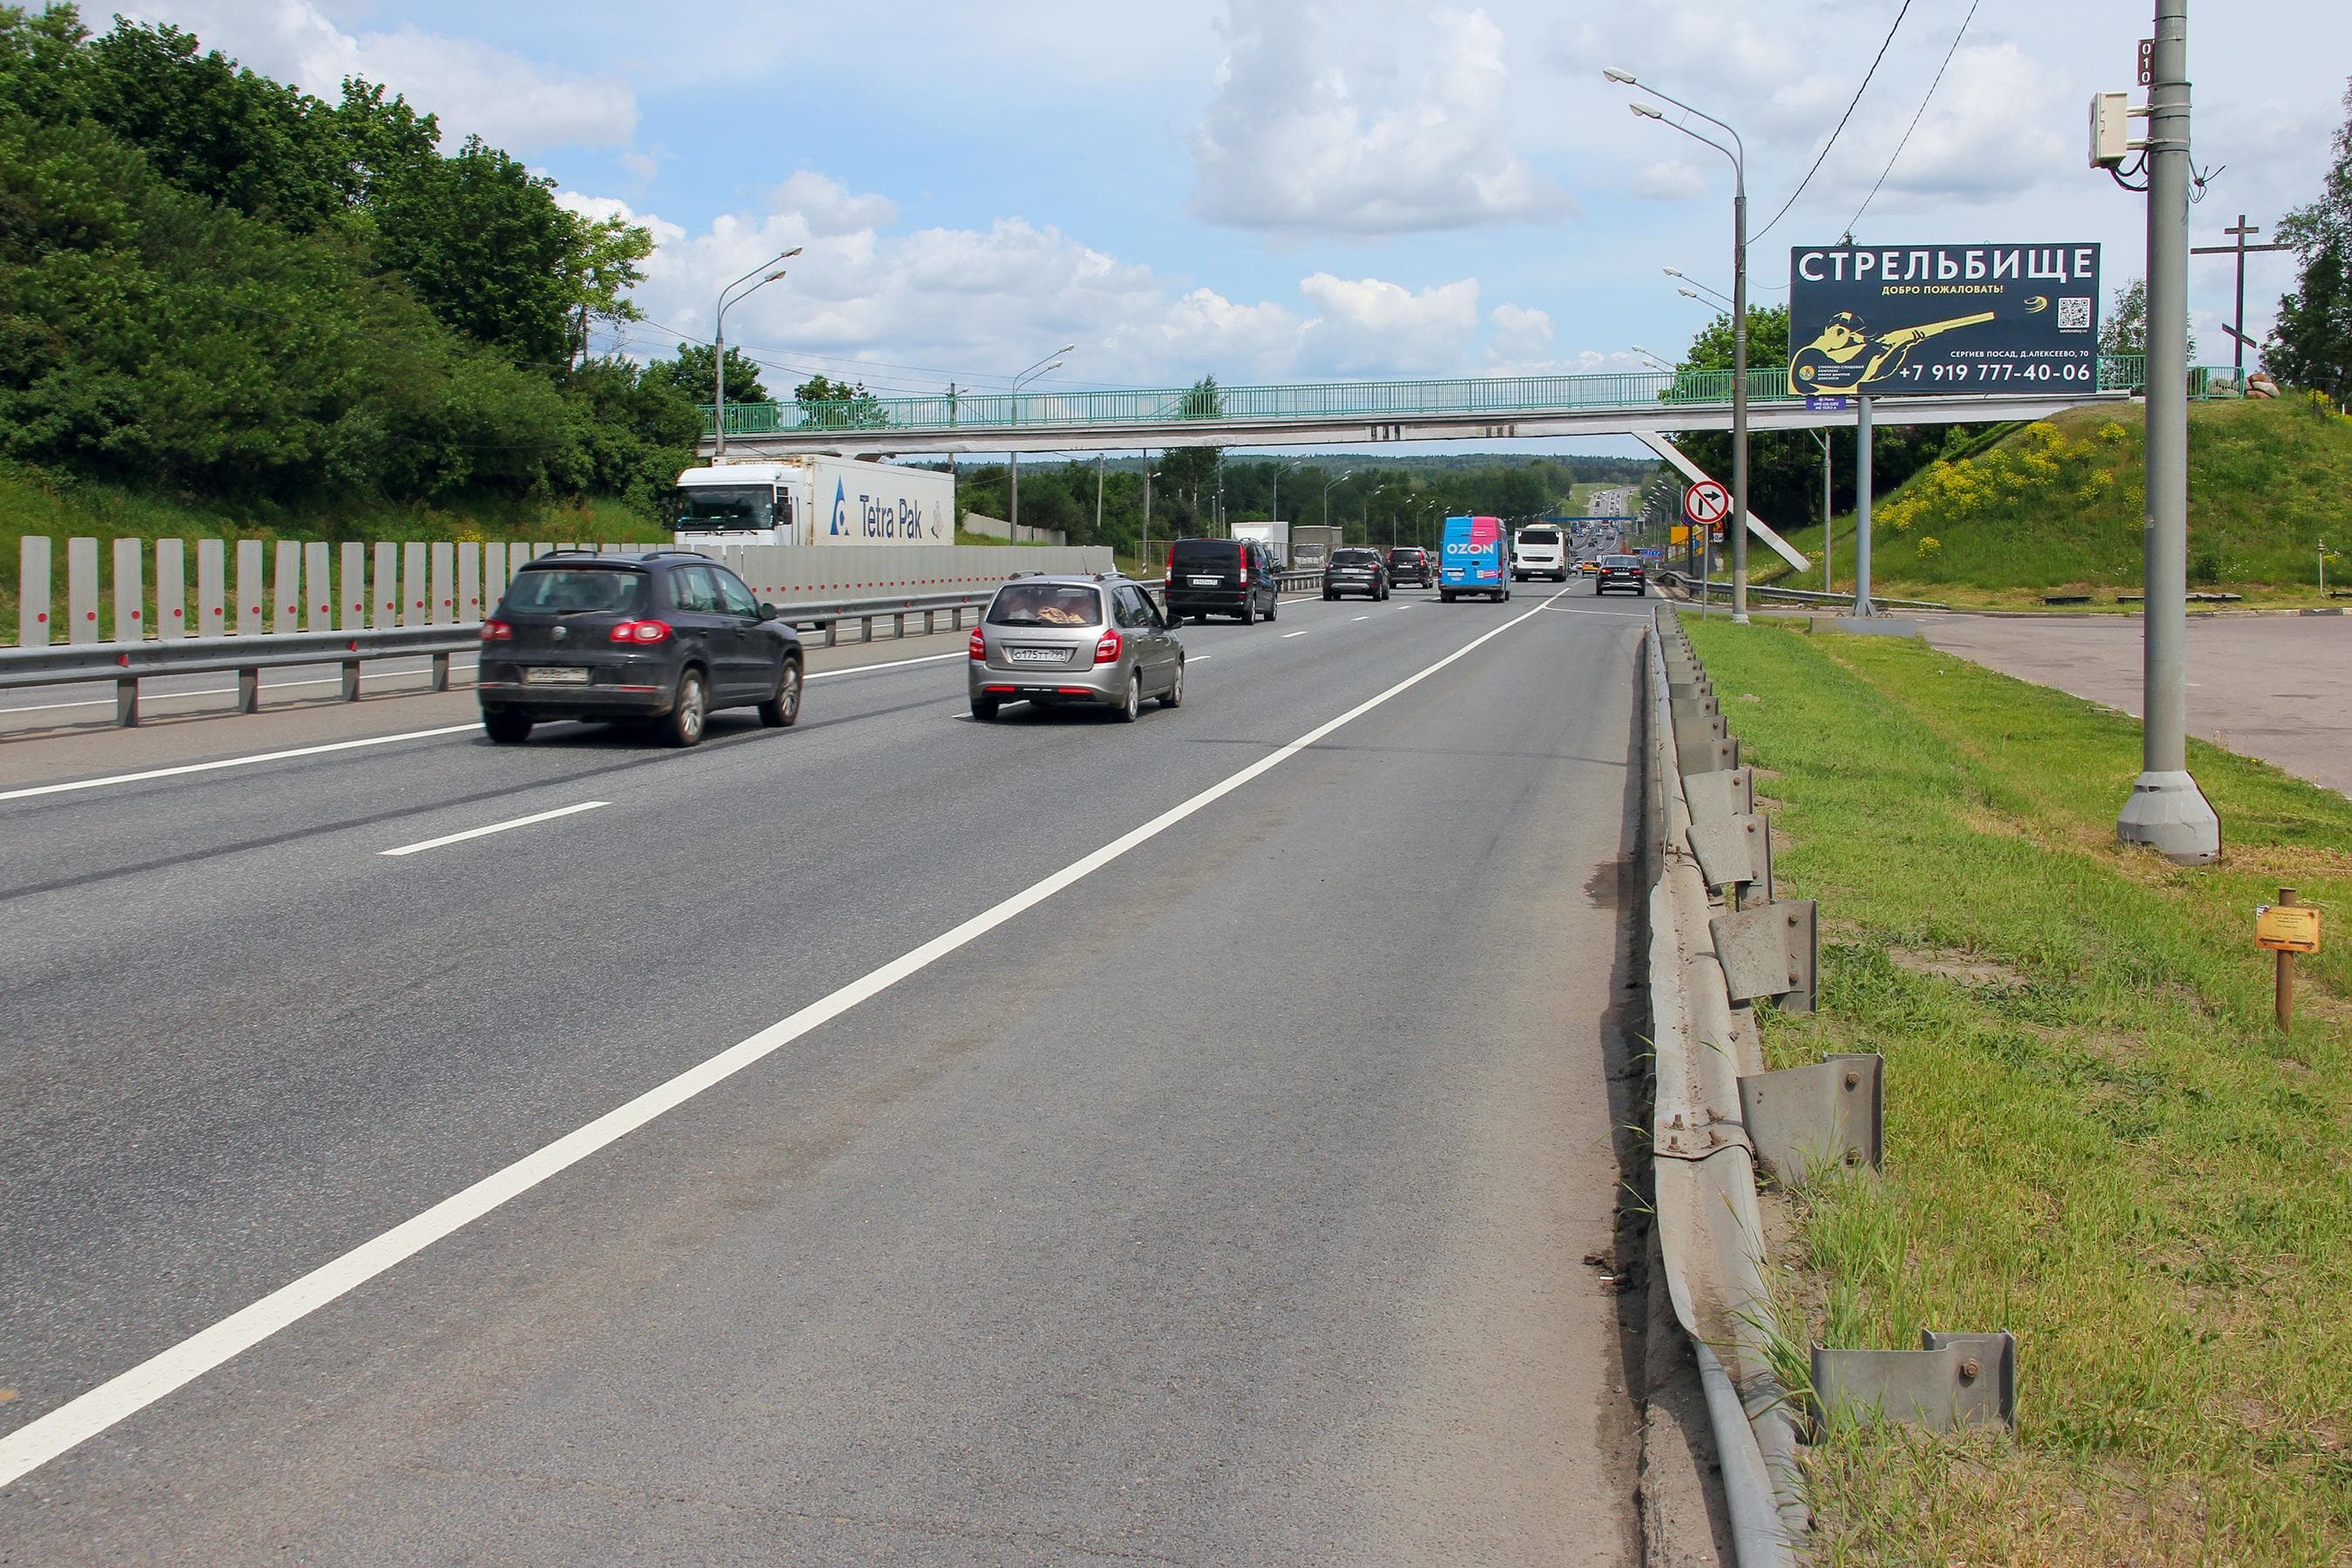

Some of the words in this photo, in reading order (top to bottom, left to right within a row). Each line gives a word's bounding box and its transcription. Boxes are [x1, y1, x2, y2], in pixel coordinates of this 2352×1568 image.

[2140, 43, 2152, 84] 010
[1798, 248, 2092, 283] СТРЕЛЬБИЩЕ
[1881, 285, 1920, 295] ДОБРО
[1923, 284, 2004, 294] ПОЖАЛОВАТЬ!
[1987, 350, 2018, 359] ПОСАД,
[2020, 350, 2078, 359] Д.АЛЕКСЕЕВО,
[1899, 364, 1924, 381] +7
[1931, 364, 1969, 382] 919
[1977, 363, 2091, 382] 777-40-06
[859, 494, 894, 538] Tetra
[898, 498, 922, 539] Pak
[1446, 544, 1494, 555] OZON
